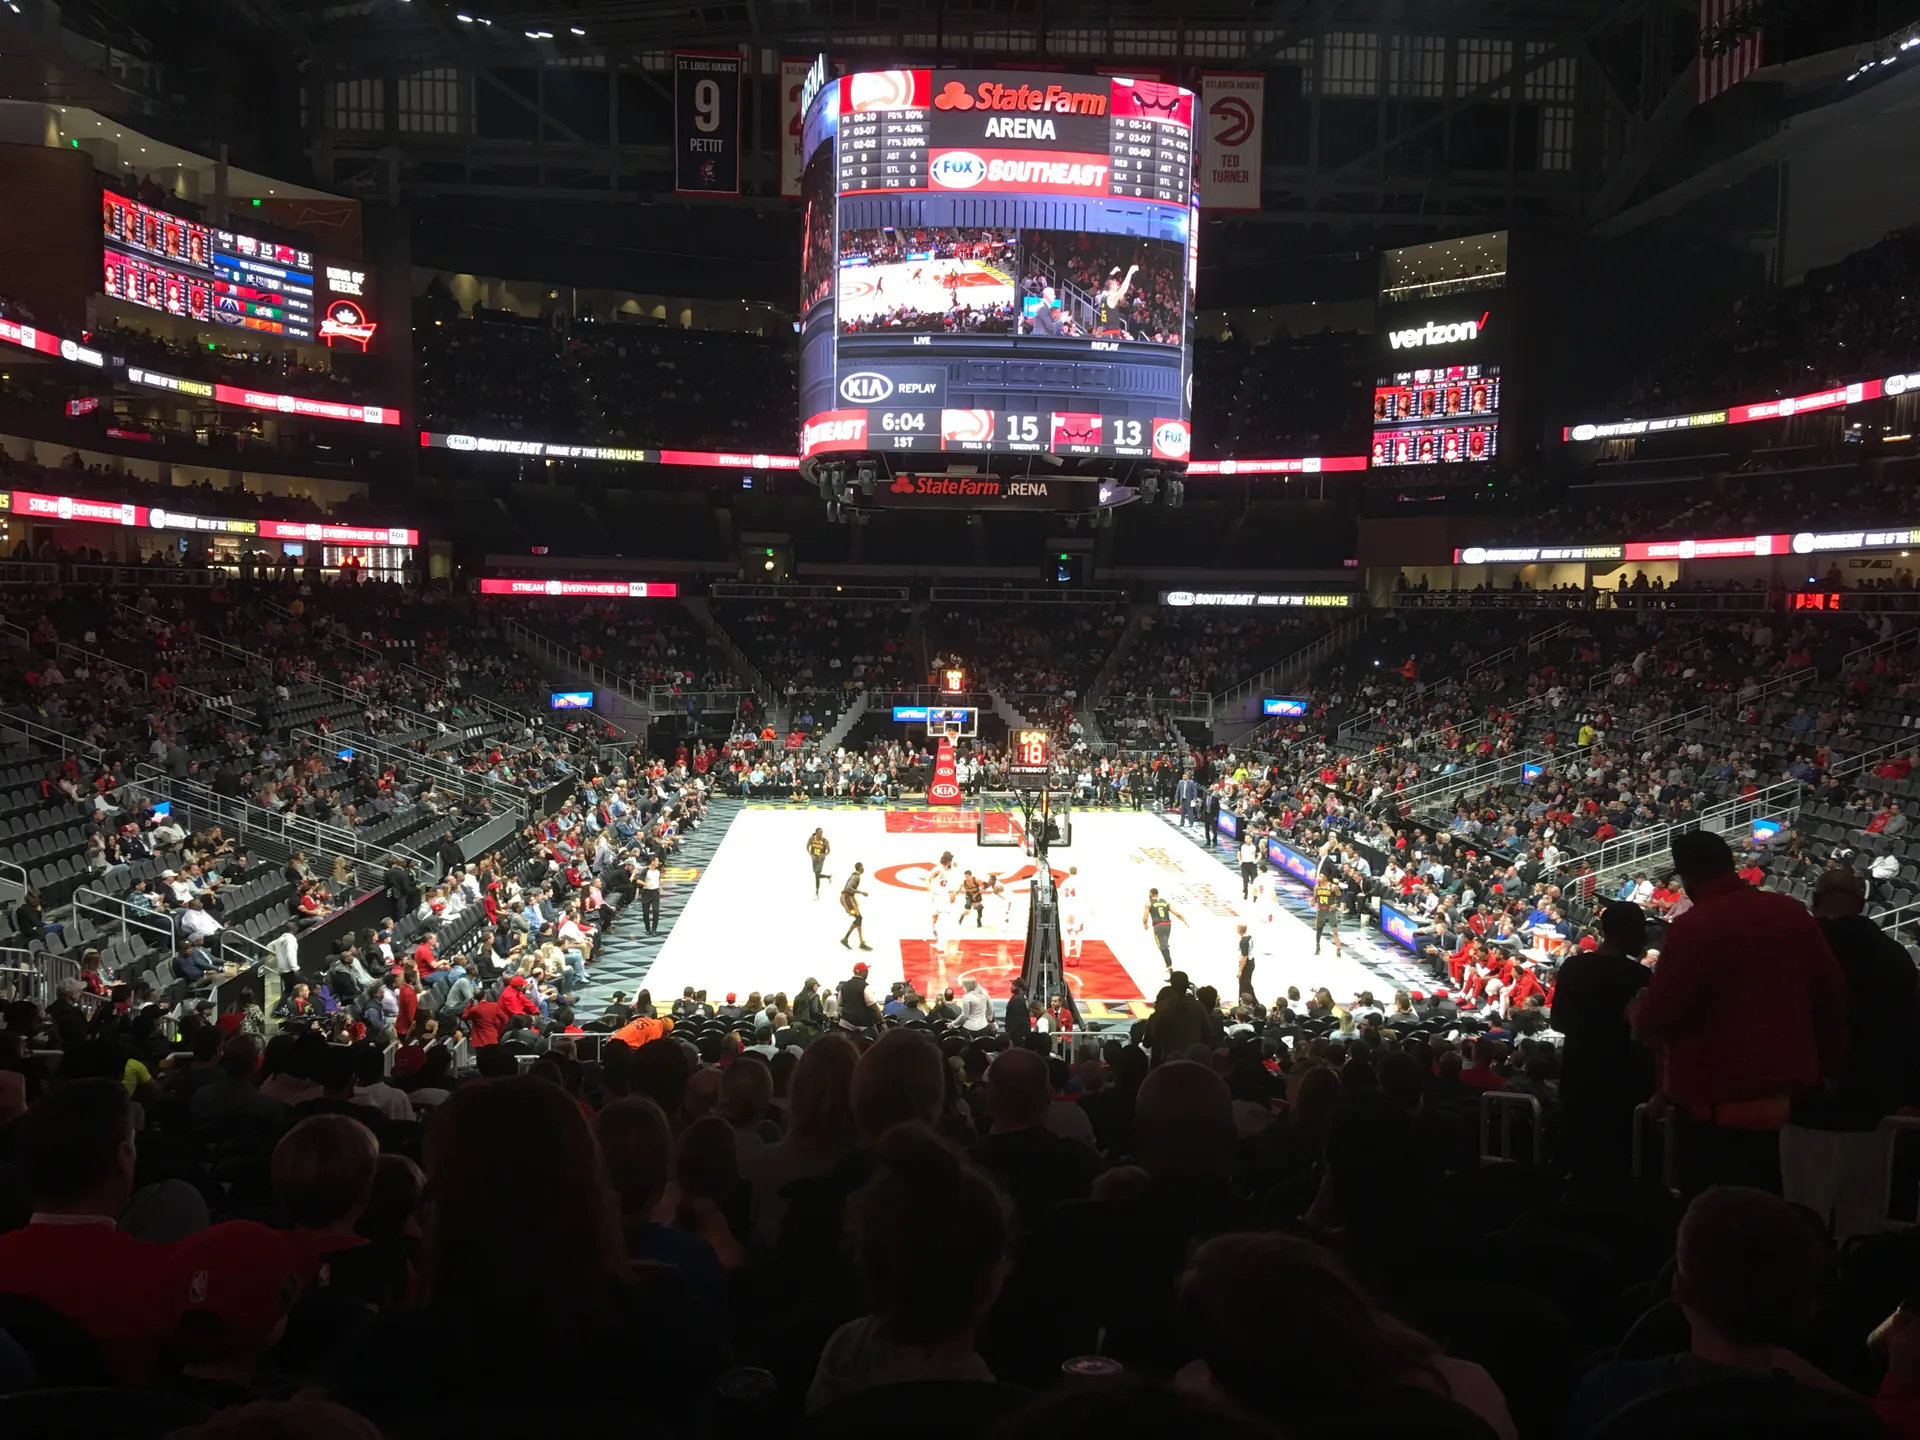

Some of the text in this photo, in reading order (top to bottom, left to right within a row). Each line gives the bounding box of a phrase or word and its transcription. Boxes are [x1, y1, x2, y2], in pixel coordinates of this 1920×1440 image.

[690, 61, 710, 71] LOUIS
[712, 62, 737, 72] HAWKS
[695, 79, 720, 132] 9
[985, 117, 1056, 140] ARENA
[1115, 118, 1125, 127] FG
[1129, 119, 1152, 130] 05-14
[853, 126, 877, 136] 03-07
[842, 142, 849, 150] FT
[853, 139, 877, 149] 02-02
[902, 138, 925, 147] 100%
[1115, 132, 1125, 140] 3P
[1128, 133, 1151, 144] 03-07
[690, 138, 724, 153] PETTIT
[1115, 145, 1123, 153] FT
[1128, 146, 1151, 158] 00-00
[886, 152, 900, 160] AST
[909, 151, 917, 160] 4
[1221, 154, 1240, 168] TED
[860, 166, 867, 176] 0
[886, 165, 899, 174] STL
[909, 164, 917, 174] 0
[943, 159, 1108, 187] FOX SOUTHEAST
[1113, 172, 1128, 181] BLK
[1136, 173, 1142, 183] 1
[1212, 170, 1249, 183] TURNER
[841, 178, 917, 190] TO 2 FLS 0
[1113, 186, 1123, 194] TO
[1135, 187, 1142, 197] 0
[260, 242, 273, 256] 15
[298, 251, 310, 265] 13
[913, 336, 931, 345] LIVE
[1389, 321, 1477, 349] verizon
[1091, 341, 1119, 351] REPLAY
[1434, 369, 1445, 379] 15
[1467, 366, 1478, 376] 13
[178, 380, 212, 397] HAWKS
[848, 379, 936, 397] KIA REPLAY
[244, 393, 276, 407] STREAM
[296, 400, 349, 417] EVERYWHERE
[349, 408, 363, 418] ON
[882, 412, 926, 431] 6:04
[1689, 412, 1725, 427] HAWKS
[1007, 415, 1039, 441] 15
[1113, 419, 1142, 446] 13
[893, 436, 914, 448] 1ST
[962, 441, 992, 450] FOULS 0
[1009, 443, 1040, 451] TIMEOUTS
[477, 438, 543, 455] SOUTHEAST
[598, 448, 645, 461] HAWKS
[1071, 445, 1091, 453] FOULS
[1115, 447, 1151, 456] TIMEOUTS 7
[719, 455, 751, 465] STREAM
[375, 531, 388, 542] ON
[1584, 547, 1621, 559] HAWKS
[512, 583, 544, 592] STREAM
[563, 584, 615, 595] EVERYWHERE
[616, 586, 628, 594] ON
[1195, 594, 1255, 606] SOUTHEAST
[1305, 596, 1348, 606] HAWKS
[1020, 731, 1047, 744] 6:04
[1024, 744, 1043, 764] 18
[1064, 887, 1076, 898] 24
[1319, 896, 1329, 905] 24
